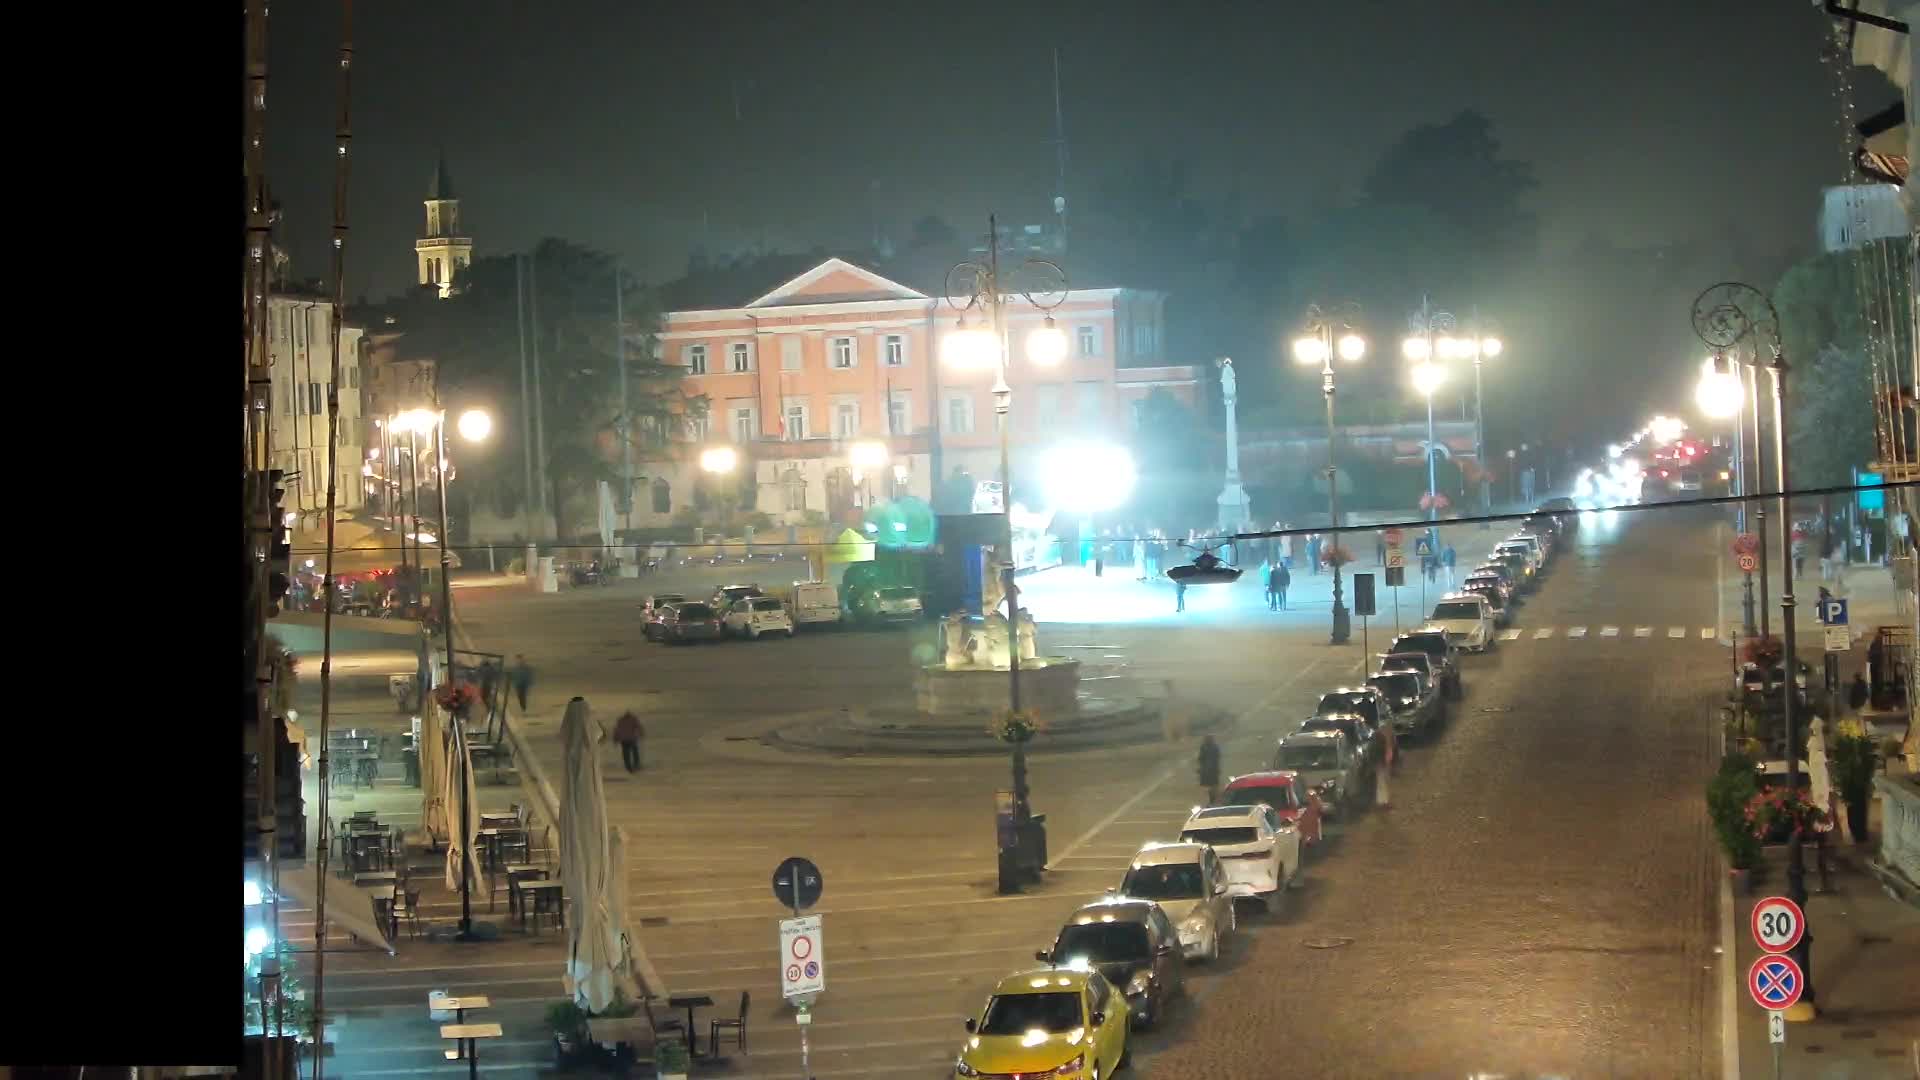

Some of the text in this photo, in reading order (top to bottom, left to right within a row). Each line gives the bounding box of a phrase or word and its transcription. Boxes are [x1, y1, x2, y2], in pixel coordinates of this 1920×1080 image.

[1742, 558, 1753, 567] 20
[1828, 602, 1842, 622] P
[1762, 912, 1791, 938] 30
